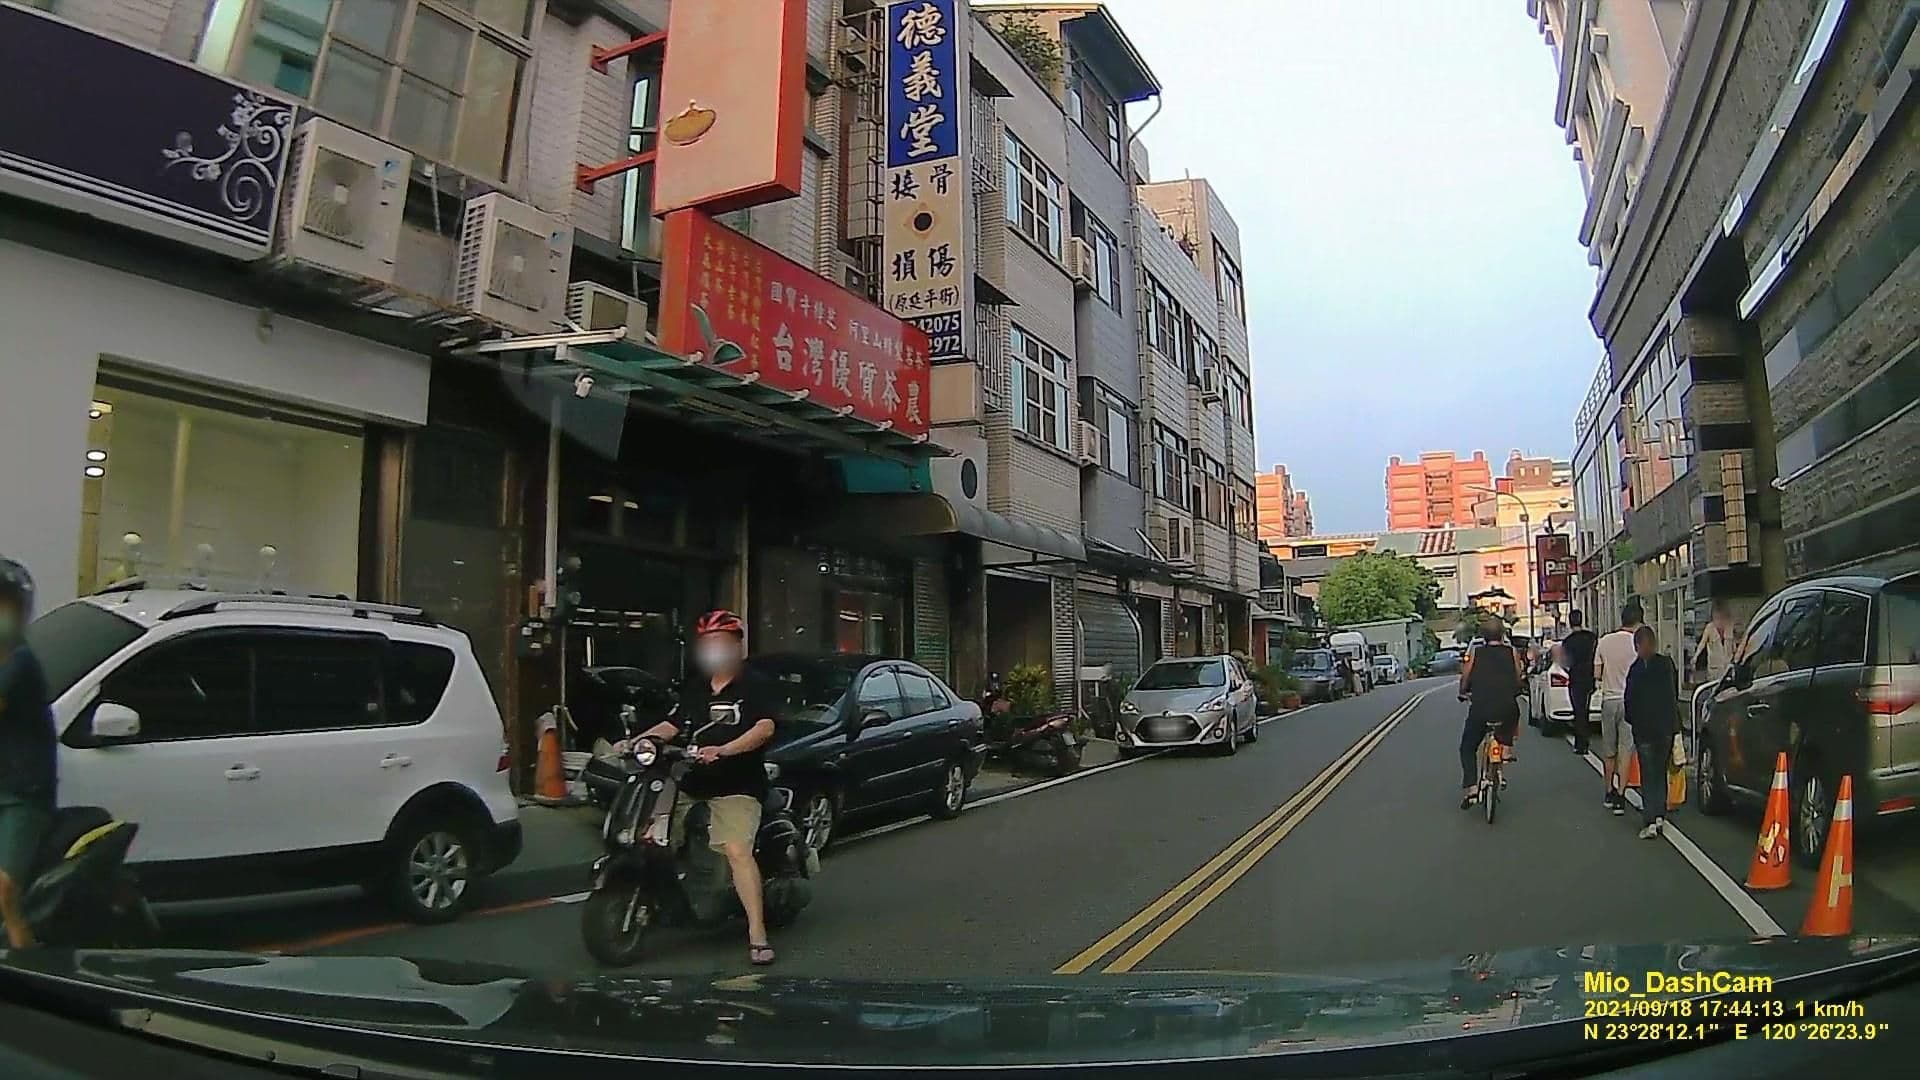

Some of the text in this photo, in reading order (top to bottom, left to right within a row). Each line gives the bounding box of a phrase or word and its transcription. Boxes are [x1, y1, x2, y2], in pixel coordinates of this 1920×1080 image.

[896, 2, 947, 159] 德義堂
[890, 163, 954, 201] 接骨
[891, 242, 956, 282] 損傷
[908, 314, 960, 333] 42075
[771, 322, 924, 426] 台灣優質茶農
